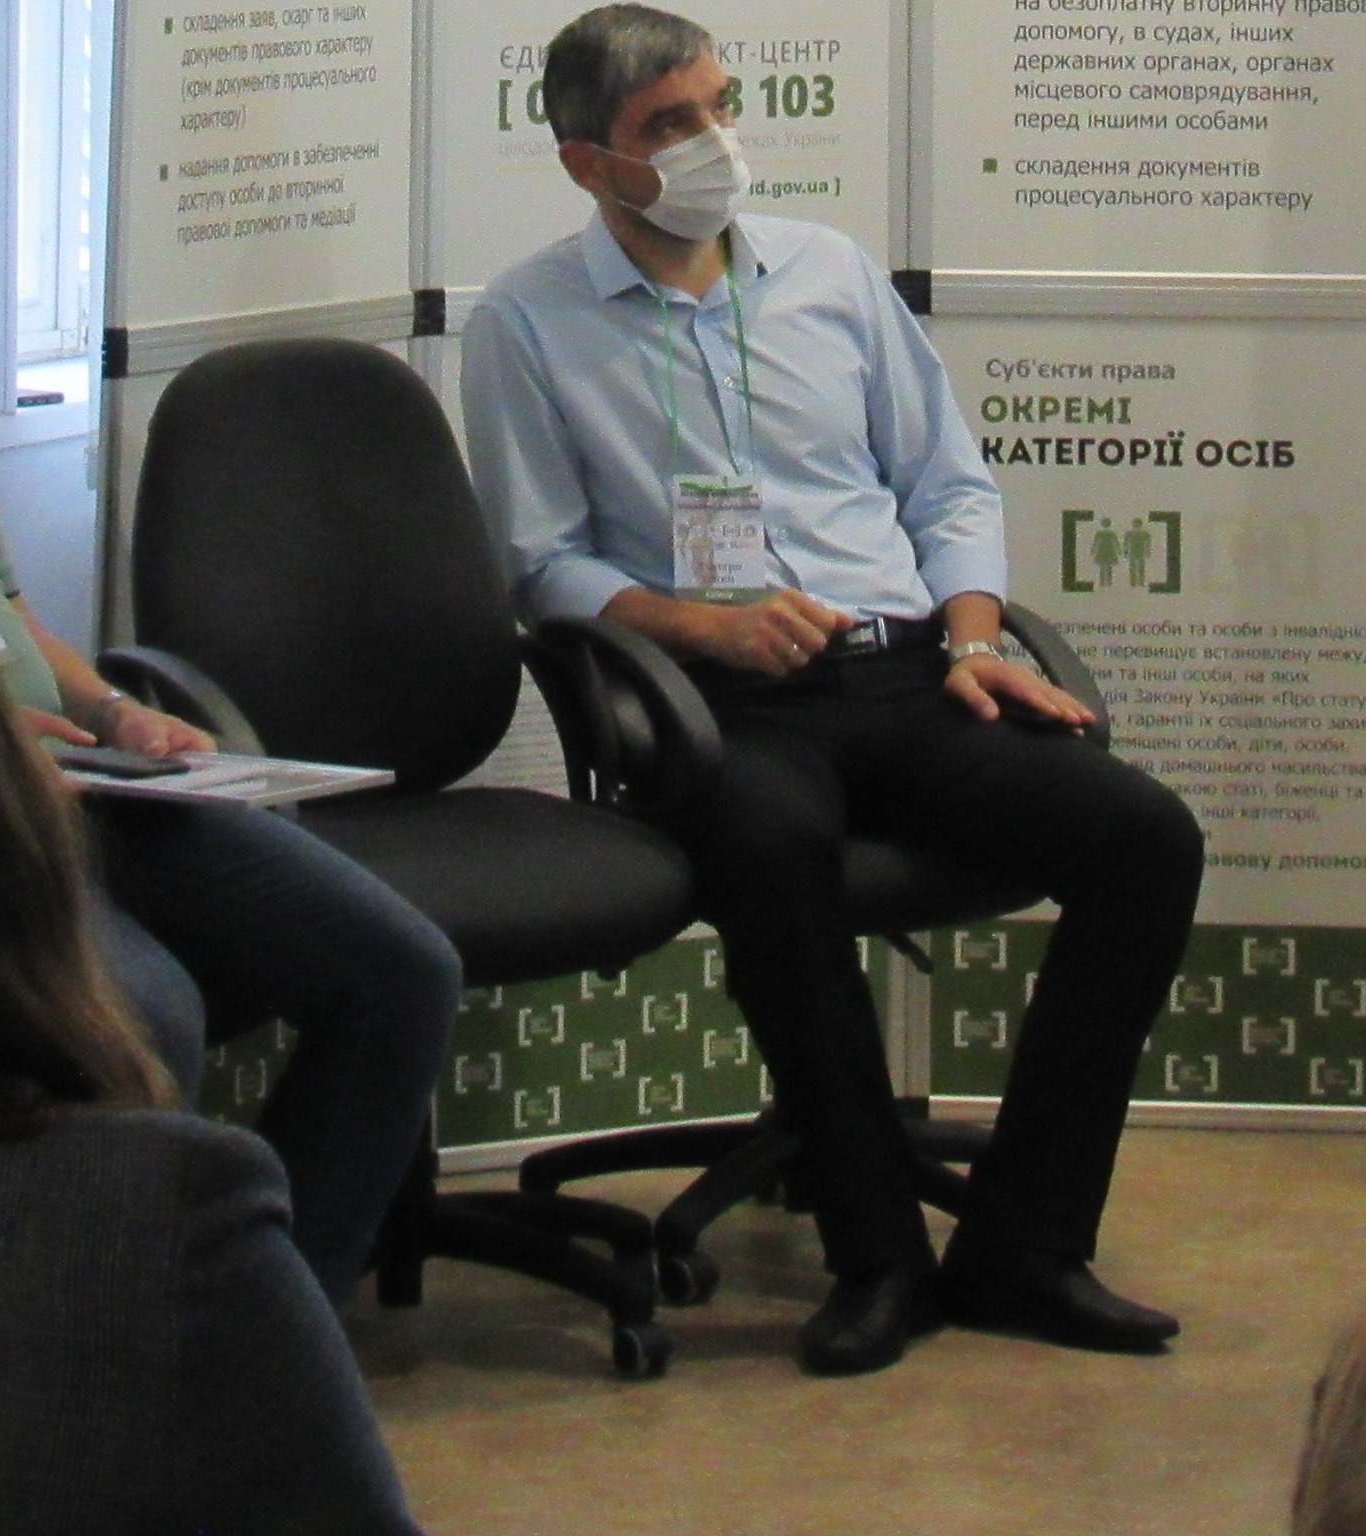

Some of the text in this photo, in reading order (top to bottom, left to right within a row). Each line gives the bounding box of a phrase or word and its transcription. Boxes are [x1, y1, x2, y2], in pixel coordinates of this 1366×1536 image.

[183, 11, 245, 32] складення
[282, 8, 313, 32] скарг
[317, 6, 329, 22] та
[1013, 24, 1294, 45] допомогу, в судах, інших
[182, 35, 373, 68] документів правового характеру
[1013, 54, 1334, 75] державних органах, органах
[215, 71, 281, 100] документів
[285, 65, 377, 93] процесуального
[1014, 82, 1319, 105] місцевого самоврядування,
[759, 74, 835, 119] 103
[180, 105, 248, 133] характеру)
[1014, 110, 1268, 132] перед іншими особами
[179, 138, 380, 178] надання допомоги в забезпеченні
[1015, 157, 1260, 180] складення документів
[178, 189, 225, 214] доступу
[229, 182, 264, 205] особи
[268, 184, 283, 204] до
[1015, 187, 1314, 212] процесуального характеру
[177, 219, 231, 245] правової
[235, 213, 290, 238] допомоги
[295, 213, 307, 230] та
[1101, 362, 1176, 383] права
[980, 394, 1132, 424] ОКРЕМІ
[982, 430, 1295, 468] КАТЕГОРІЇ ОСІБ
[1132, 619, 1182, 637] особи
[1188, 624, 1206, 637] та
[1212, 620, 1263, 637] особи
[1203, 647, 1311, 664] встановлену
[1119, 668, 1137, 681] та
[1244, 671, 1265, 683] на
[1137, 688, 1193, 708] Закону
[1200, 689, 1265, 709] України
